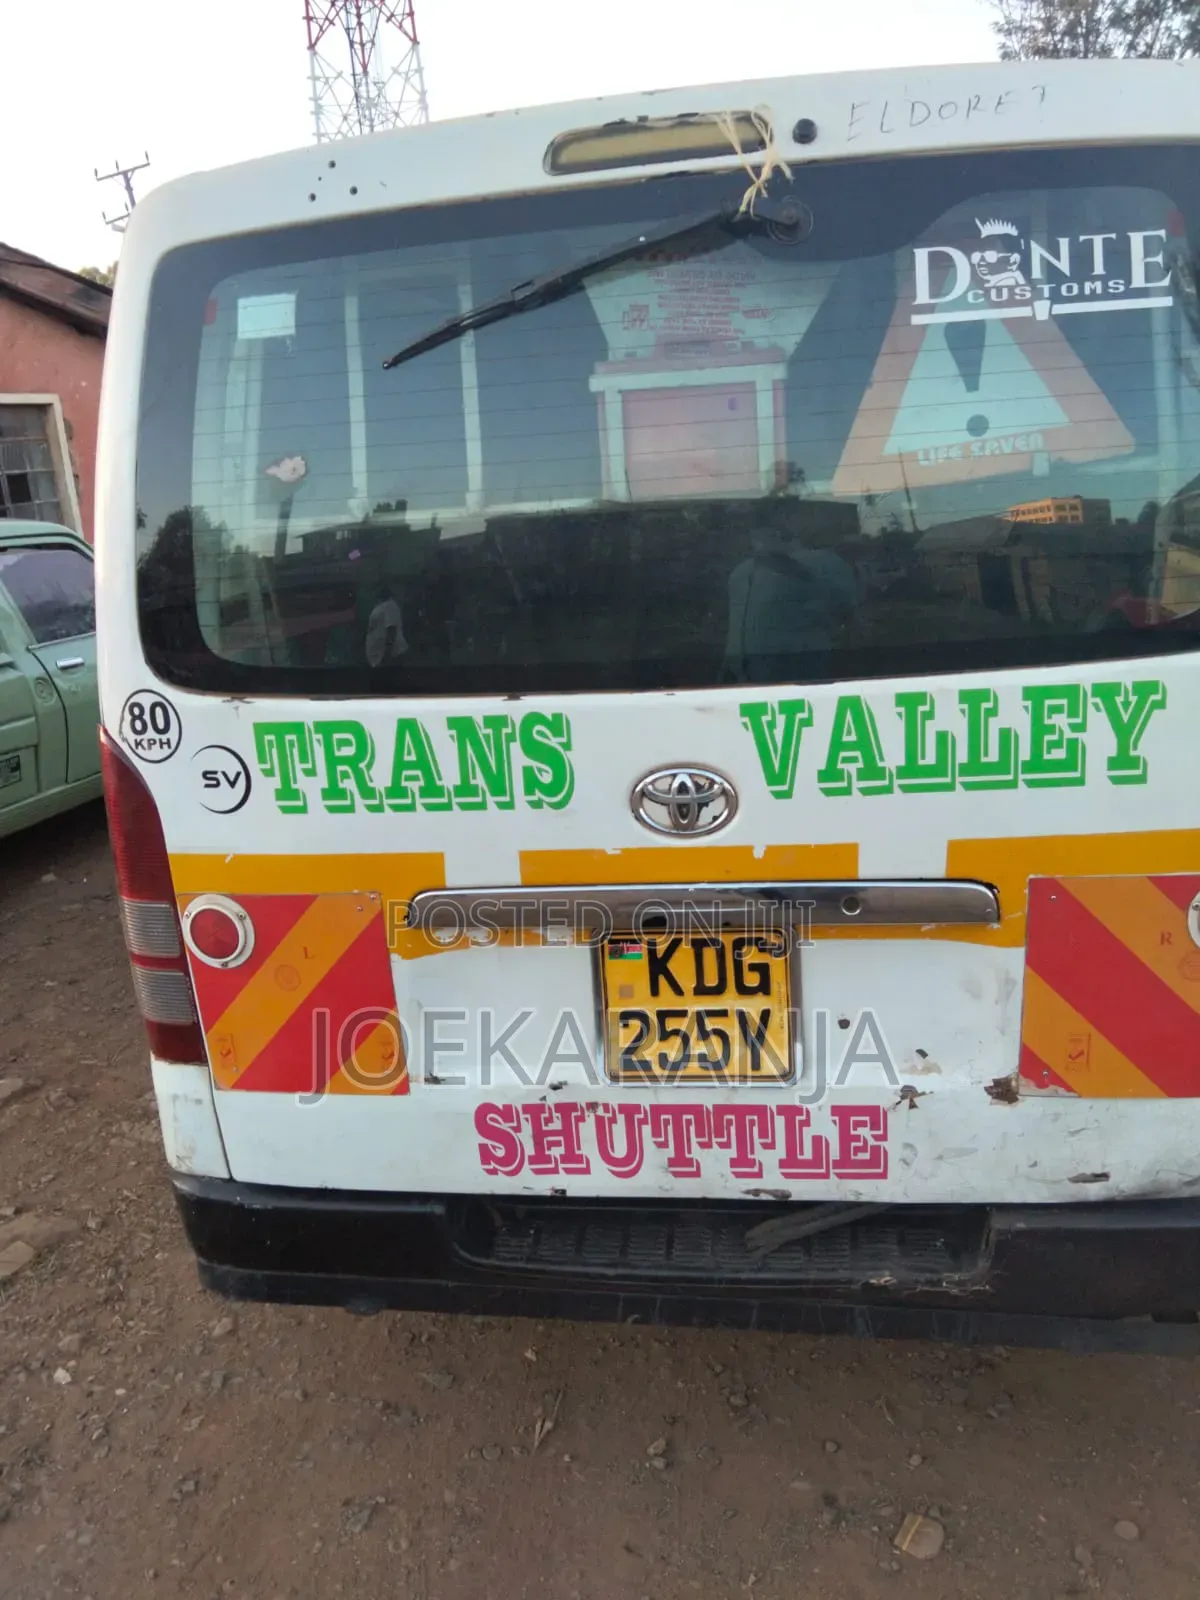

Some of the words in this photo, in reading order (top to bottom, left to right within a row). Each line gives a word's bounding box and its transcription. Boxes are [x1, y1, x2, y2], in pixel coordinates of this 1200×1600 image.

[912, 229, 1173, 305] DNTE
[967, 279, 1125, 304] CUSTOMS
[917, 446, 963, 467] LIFE
[128, 701, 171, 735] 80
[134, 738, 172, 751] KPH
[253, 711, 575, 814] TRANS
[739, 680, 1167, 799] VALLEY
[202, 770, 242, 789] SV
[647, 937, 771, 997] KDG
[618, 1008, 771, 1072] 255Y
[474, 1102, 889, 1179] SHUTTLE
